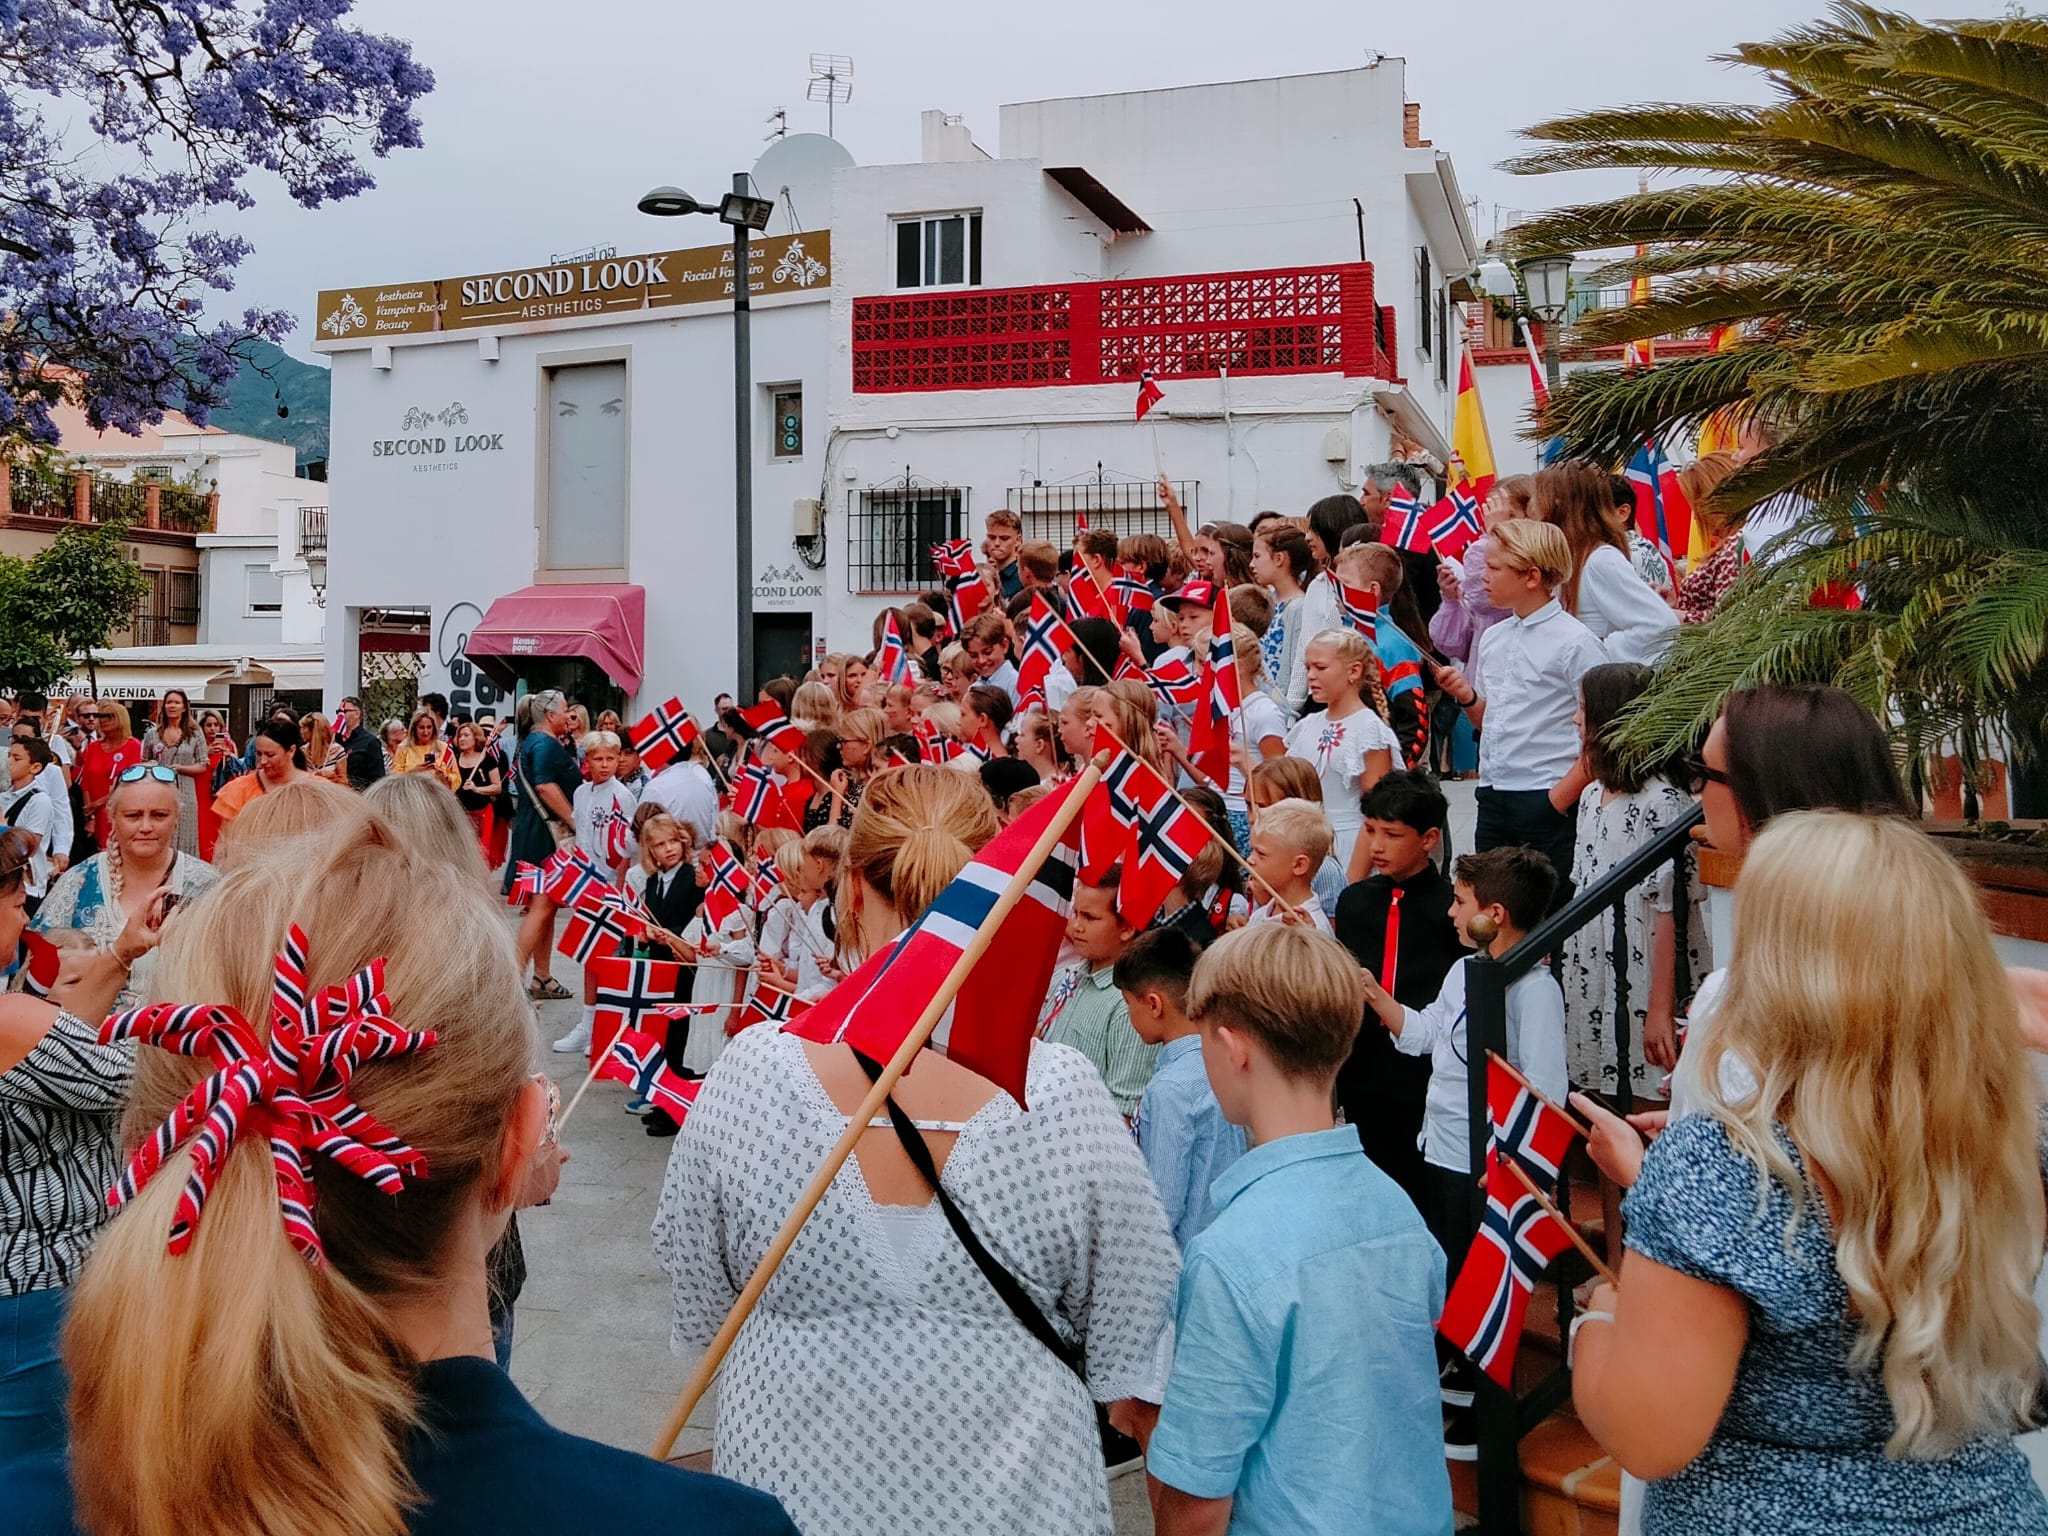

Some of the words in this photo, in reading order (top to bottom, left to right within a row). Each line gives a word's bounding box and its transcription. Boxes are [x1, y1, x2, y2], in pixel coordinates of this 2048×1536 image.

[461, 268, 574, 307] SECOND
[580, 256, 669, 293] LOOK
[681, 267, 716, 283] Facial
[375, 288, 424, 302] Aesthetics
[375, 304, 416, 317] Vampire
[521, 298, 602, 318] AESTHETICS
[375, 319, 412, 331] Beauty
[372, 437, 447, 456] SECOND
[455, 434, 504, 452] LOOK
[412, 462, 459, 472] AESTHETICS
[753, 587, 787, 597] COND
[789, 586, 823, 596] LOOK
[102, 687, 156, 697] AVENIDA
